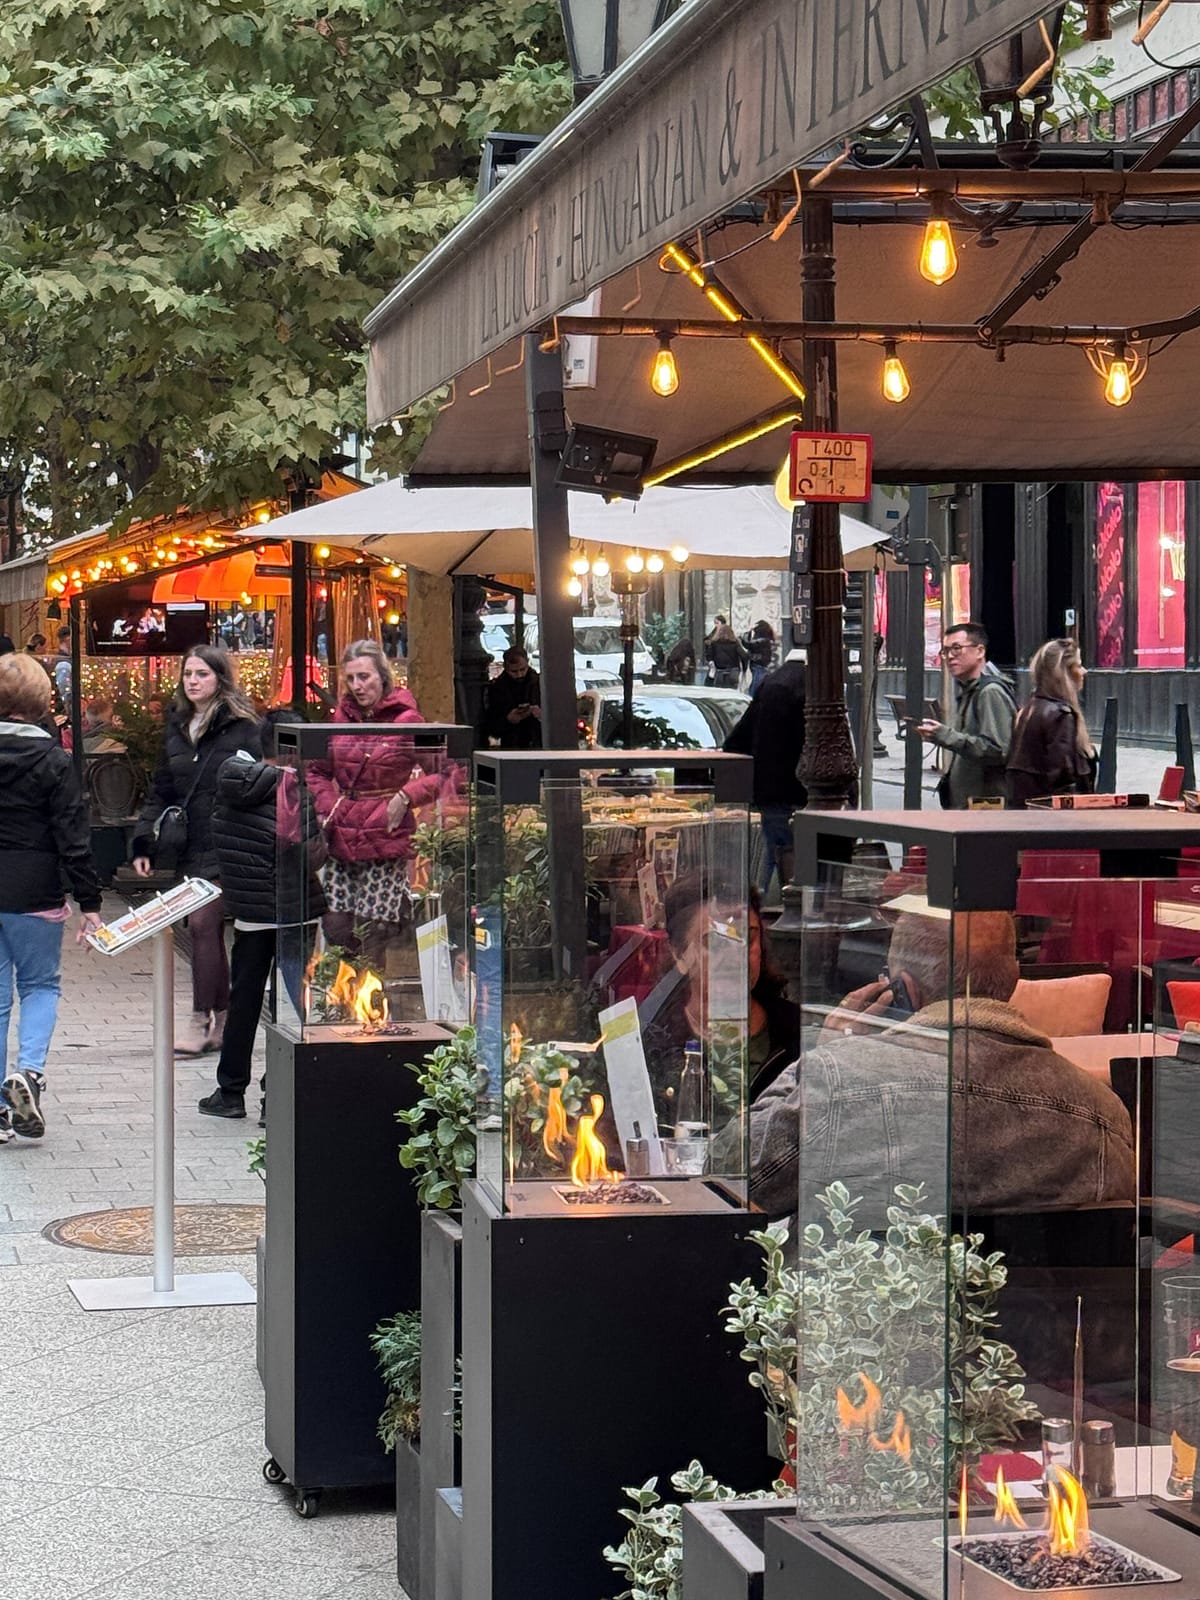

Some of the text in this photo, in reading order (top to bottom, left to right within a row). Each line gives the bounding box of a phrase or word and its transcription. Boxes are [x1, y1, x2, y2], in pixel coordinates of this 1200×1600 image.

[568, 90, 709, 284] HUNGARIAN
[719, 67, 742, 186] &
[756, 0, 1005, 166] INTER
